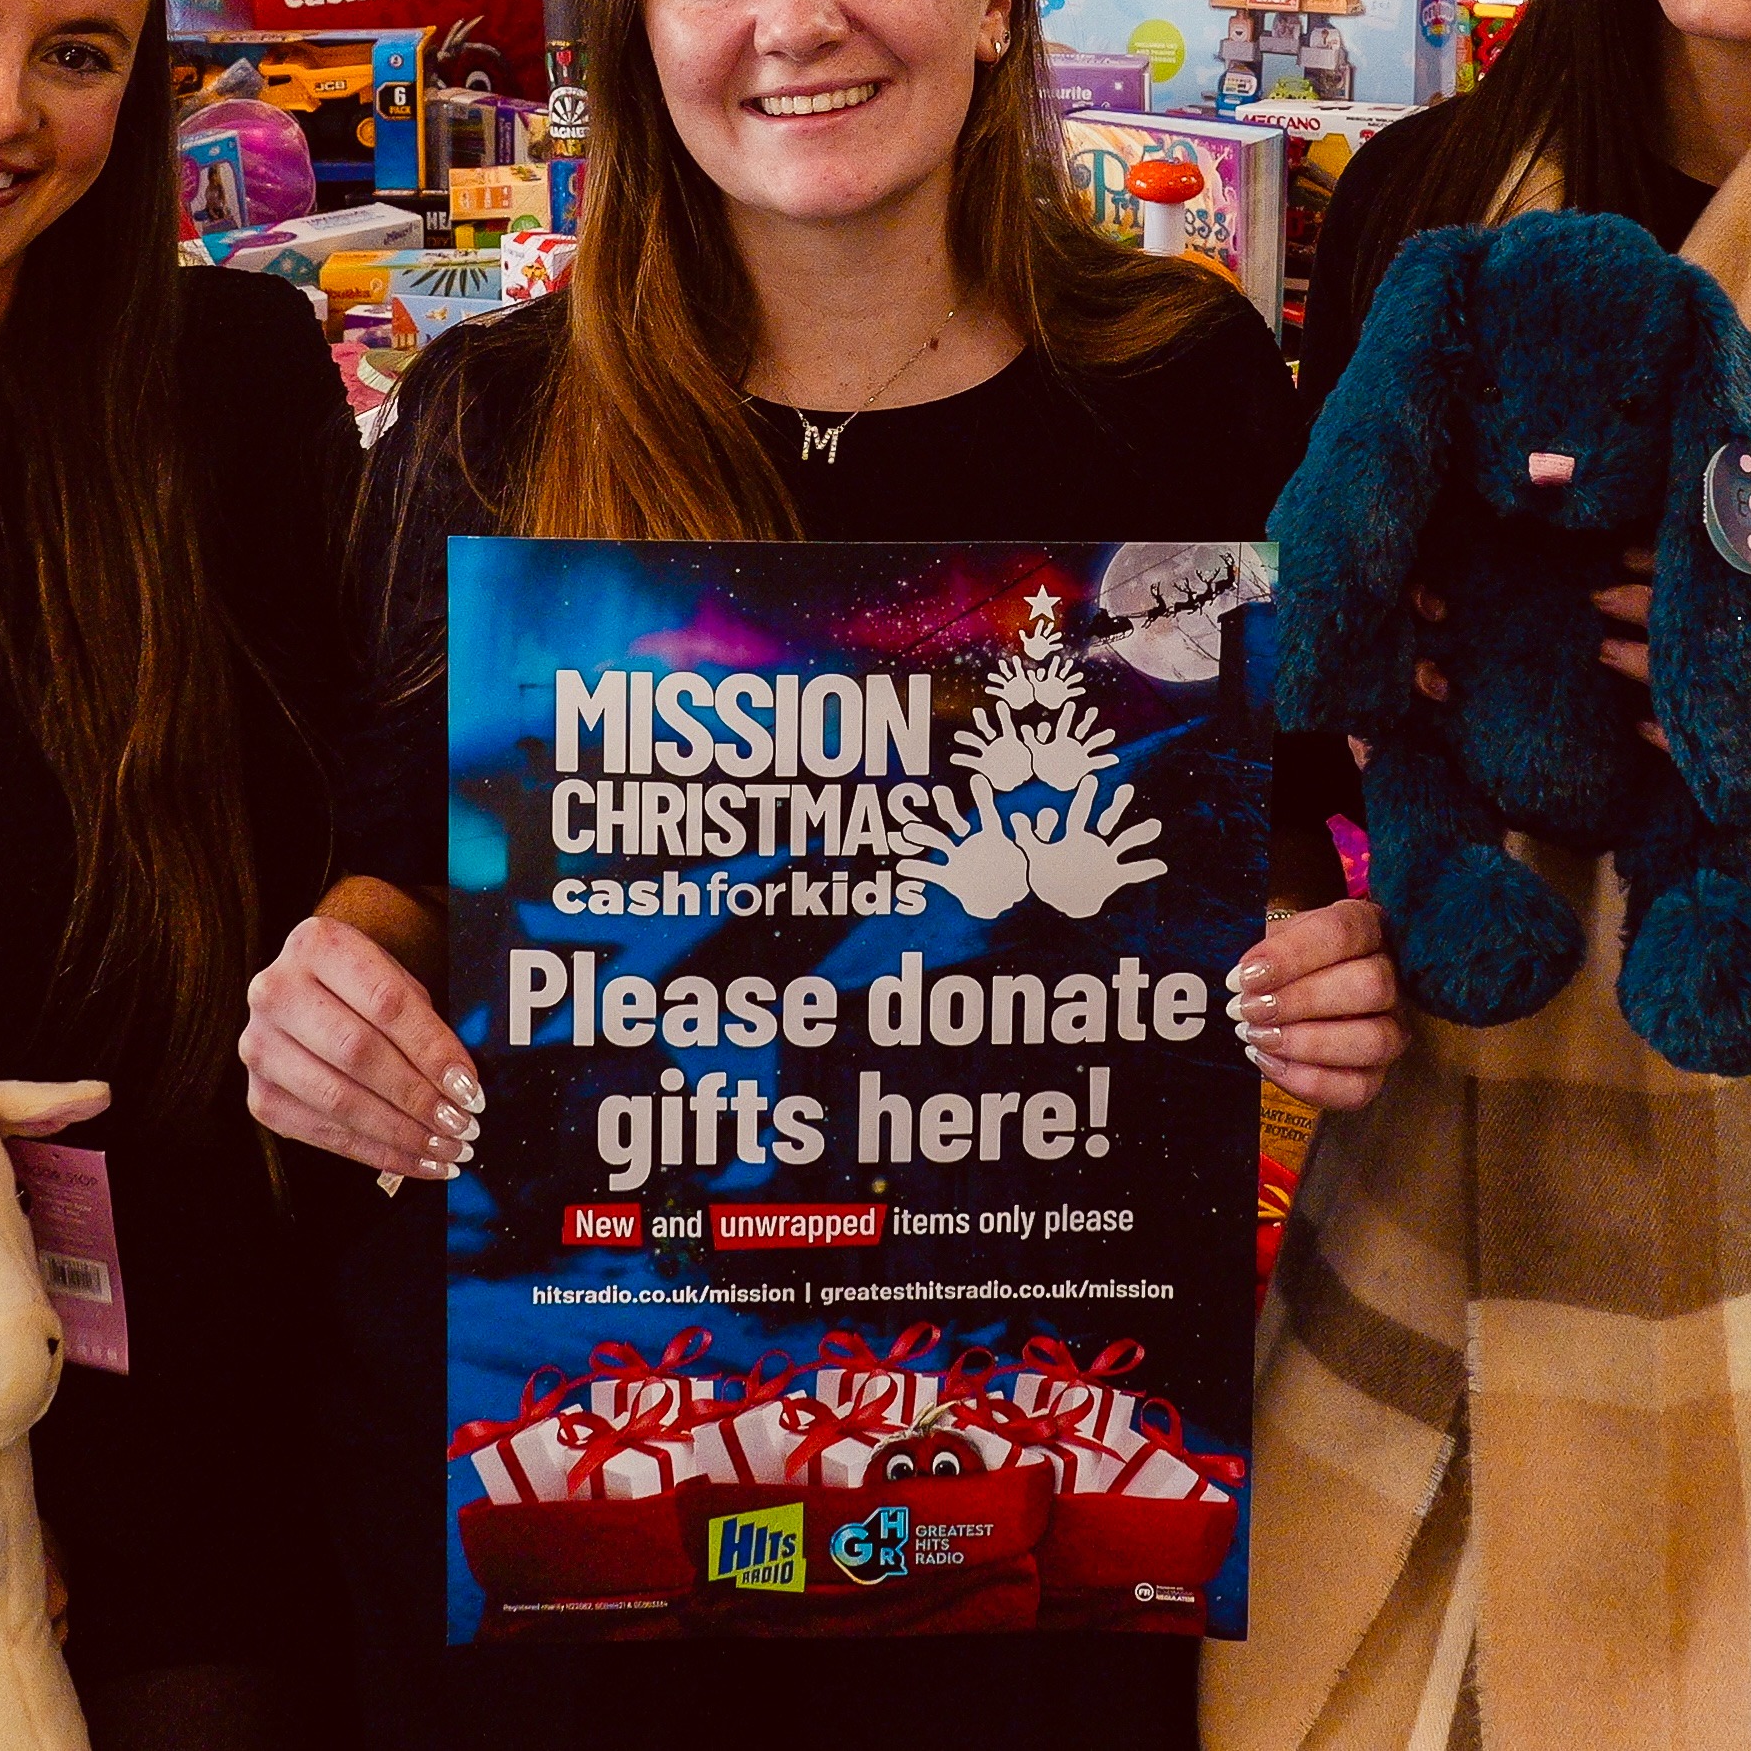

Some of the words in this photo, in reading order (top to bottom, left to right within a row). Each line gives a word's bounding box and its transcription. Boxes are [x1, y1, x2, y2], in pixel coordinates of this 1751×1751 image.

[314, 79, 346, 92] JCB
[393, 86, 406, 107] 6
[388, 105, 412, 117] PACK
[1243, 114, 1322, 132] MECCANO
[555, 668, 932, 778] MISSION
[551, 778, 930, 858] CHRISTMAS
[508, 949, 838, 1048] Please
[868, 950, 1209, 1047] donate
[596, 1067, 826, 1192] gifts
[857, 1065, 1111, 1164] here!
[573, 1209, 636, 1238] New
[651, 1209, 703, 1239] and
[719, 1207, 876, 1244] unwrapped
[892, 1206, 971, 1237] items
[978, 1204, 1037, 1241] only
[1043, 1203, 1134, 1240] please
[531, 1282, 796, 1306] hitsradio.co.uk/mission
[819, 1278, 1175, 1303] greatesthitsradio.co.uk/mission
[915, 1524, 994, 1537] GREATEST
[915, 1538, 950, 1551] HITS
[915, 1552, 965, 1566] RADIO
[741, 1559, 794, 1585] RADIO
